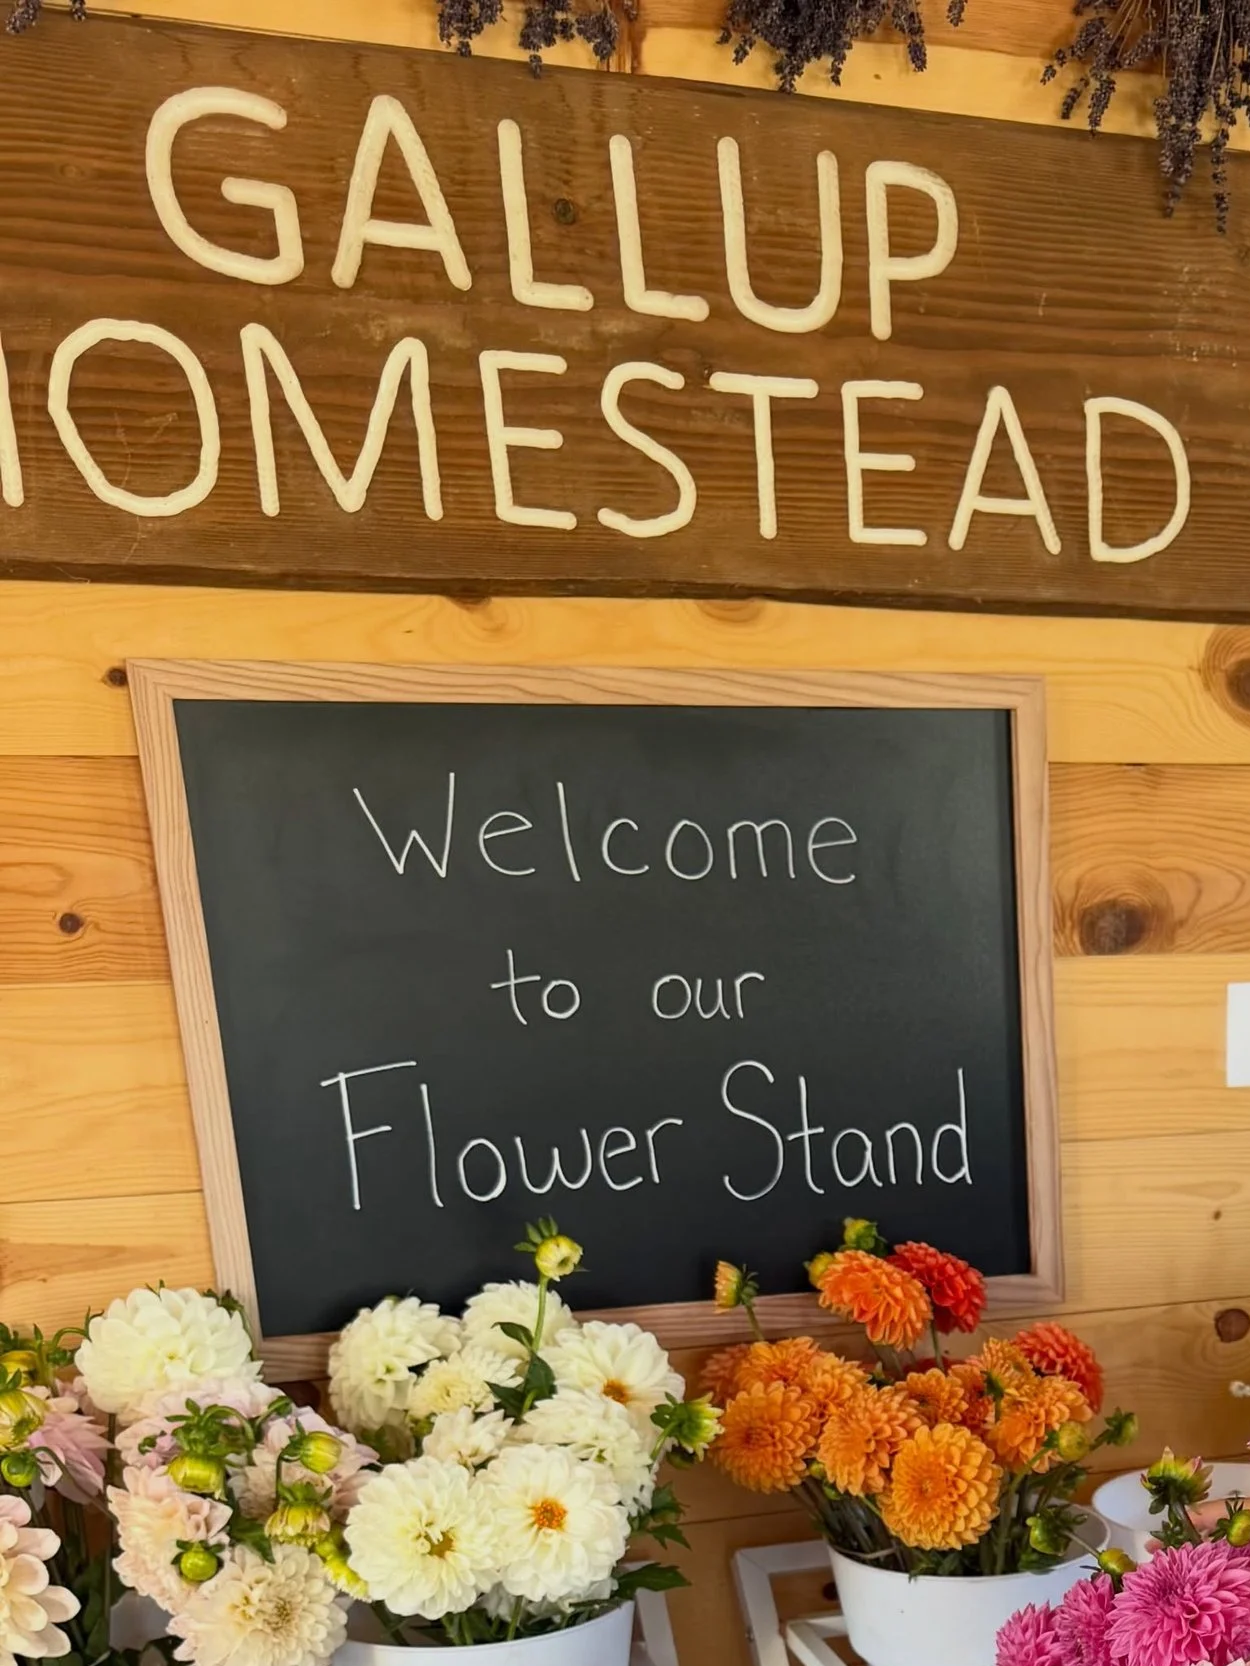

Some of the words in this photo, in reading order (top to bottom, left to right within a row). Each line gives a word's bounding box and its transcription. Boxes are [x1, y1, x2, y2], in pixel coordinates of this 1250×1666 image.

[145, 86, 960, 340] GALLUP
[353, 772, 858, 884] Welcome
[490, 948, 581, 1025] to
[652, 970, 765, 1020] our
[320, 1060, 684, 1211] Flower
[721, 1060, 973, 1201] Stand
